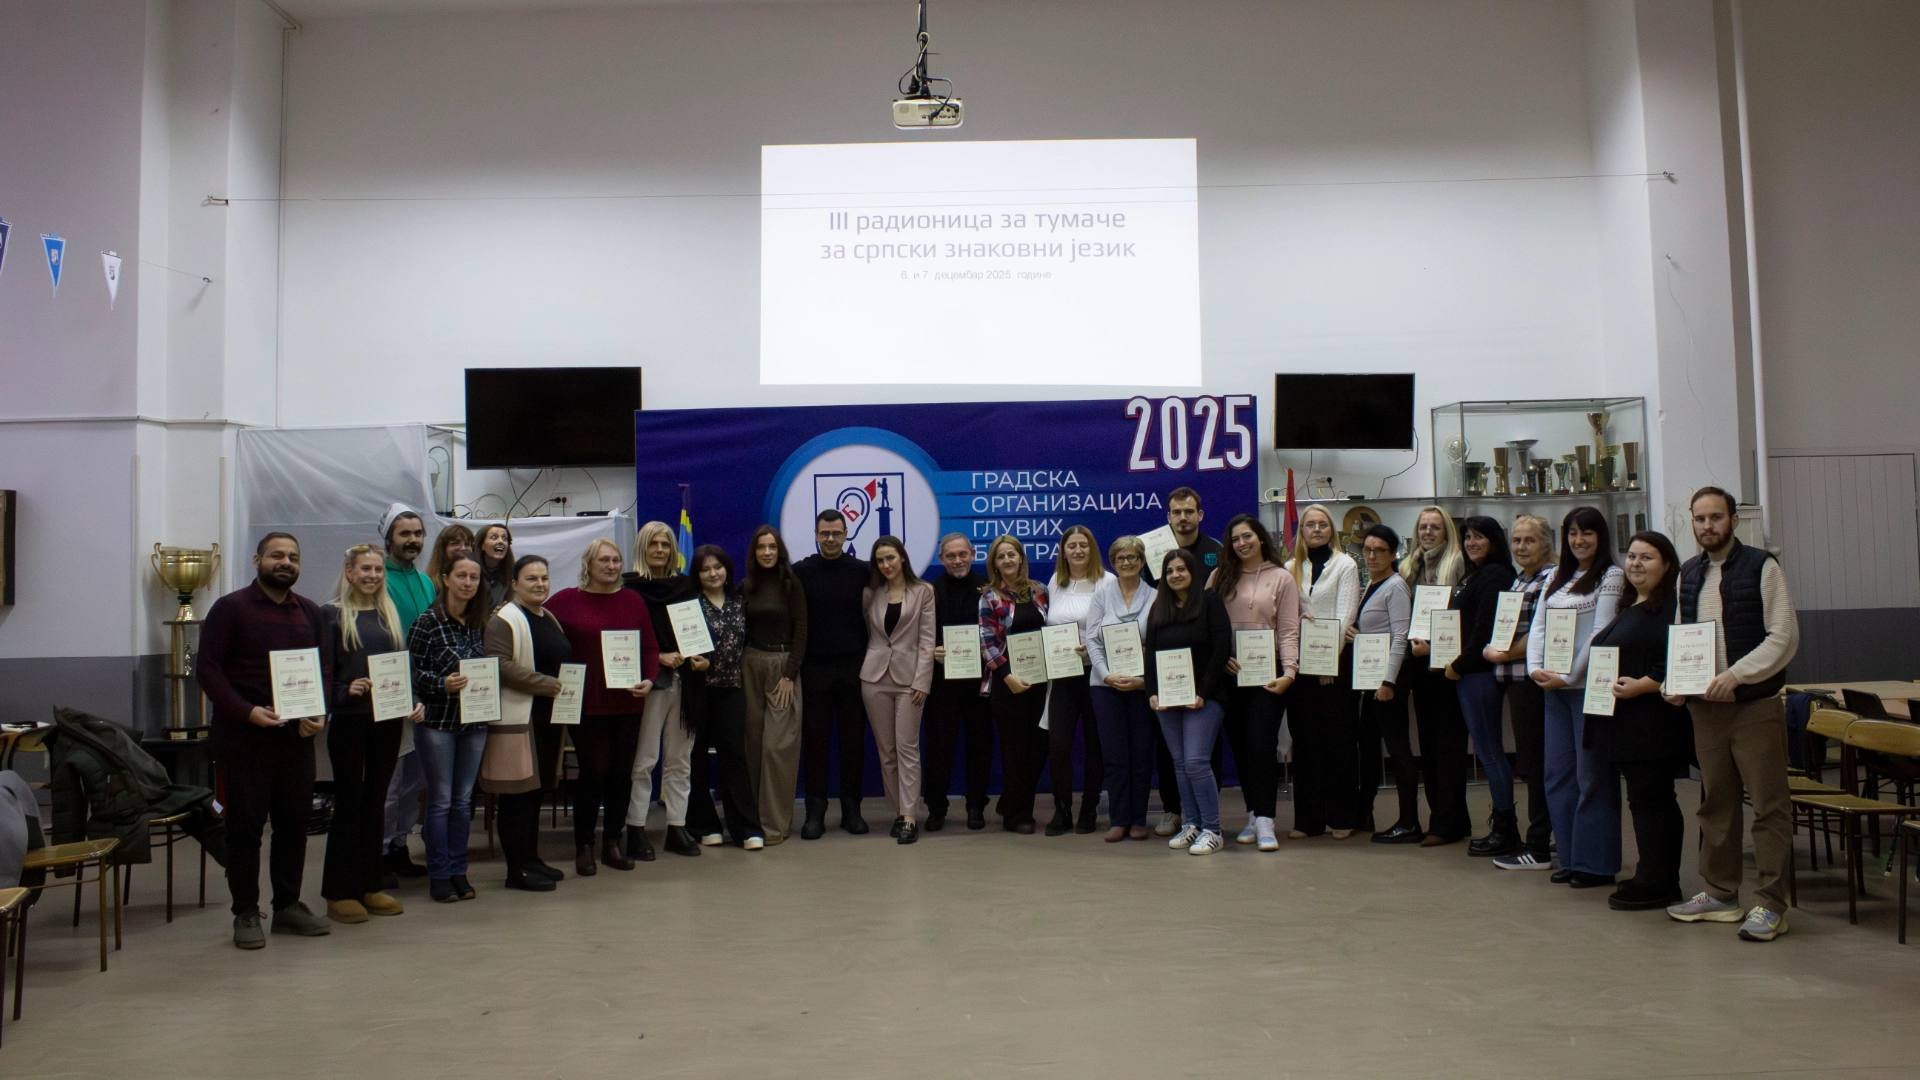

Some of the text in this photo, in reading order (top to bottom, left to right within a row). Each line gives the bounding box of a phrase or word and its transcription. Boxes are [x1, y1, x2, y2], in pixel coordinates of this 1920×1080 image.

[829, 212, 1126, 235] III радионица за тумаче
[821, 239, 1136, 264] за српски знаковни језик
[900, 270, 1052, 281] 6. и 7. децембар 2025. године
[1125, 395, 1252, 471] 2025
[972, 470, 1079, 491] ГРАДСКА
[971, 493, 1162, 514] ОРГАНИЗАЦИЈА
[974, 518, 1064, 537] ГЛУВИХ
[974, 543, 1061, 562] БГРА
